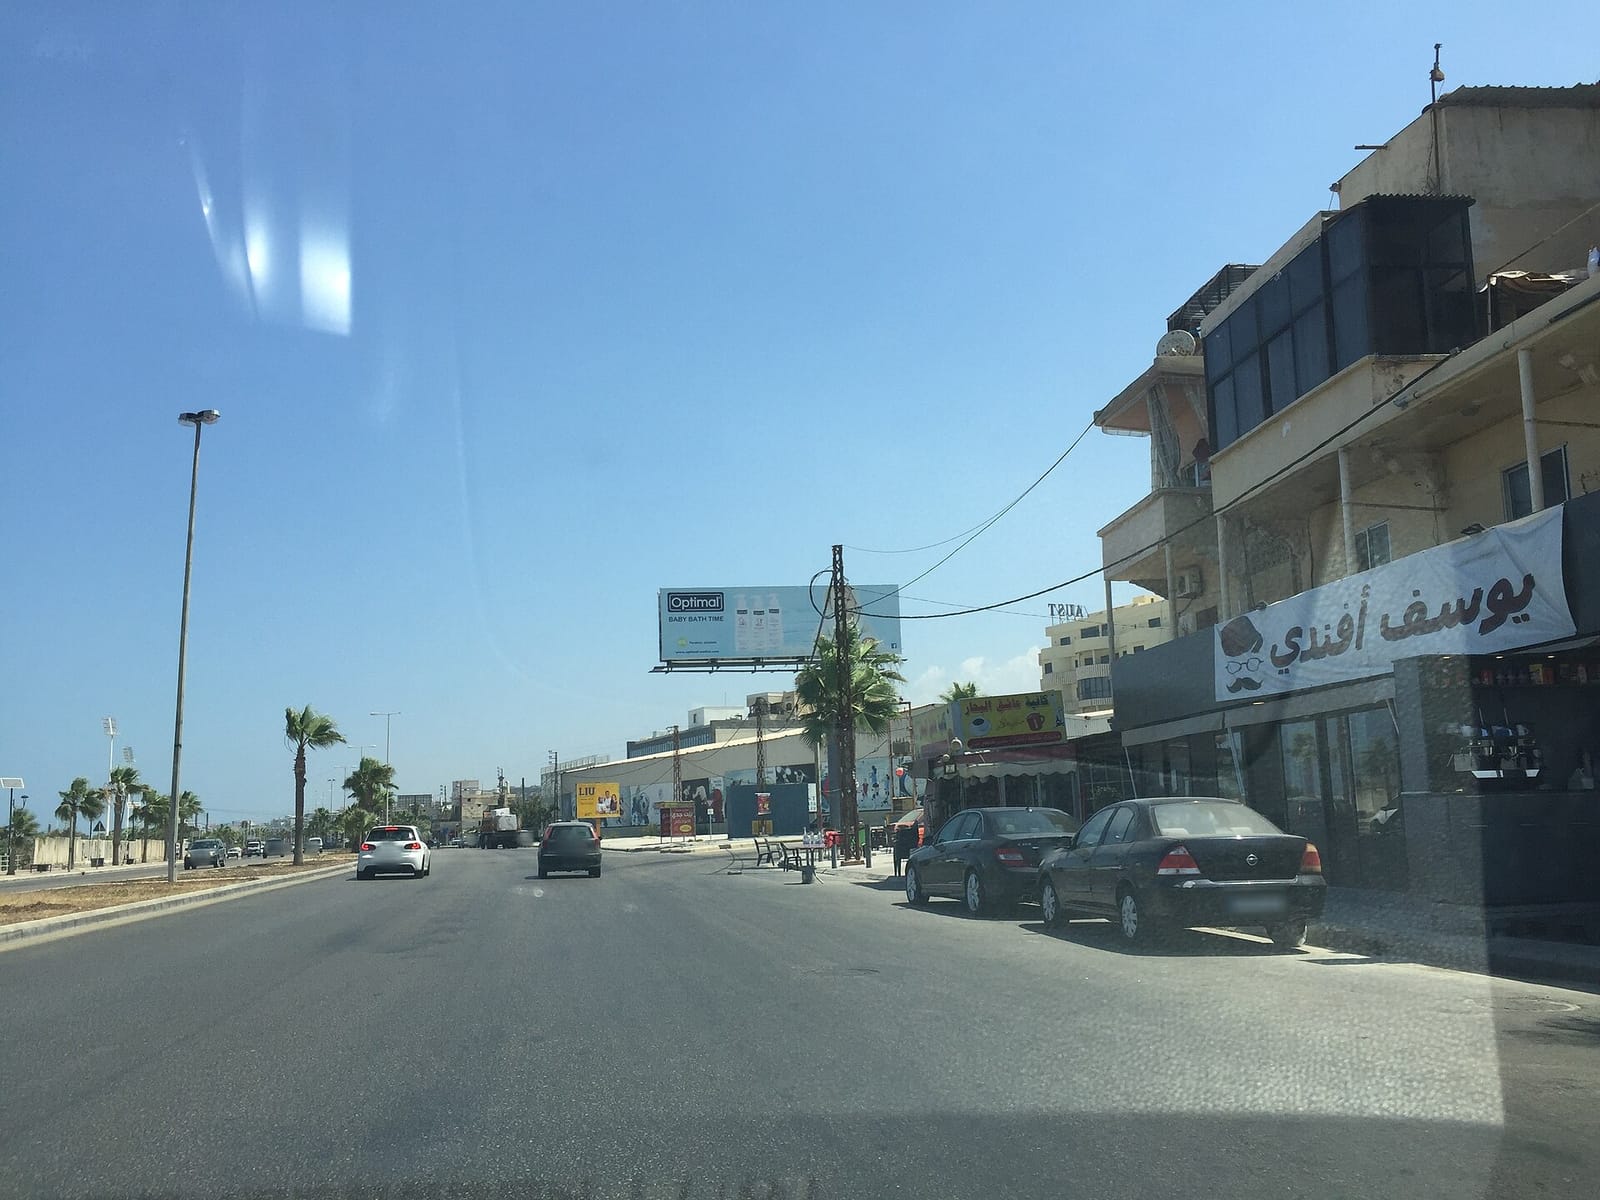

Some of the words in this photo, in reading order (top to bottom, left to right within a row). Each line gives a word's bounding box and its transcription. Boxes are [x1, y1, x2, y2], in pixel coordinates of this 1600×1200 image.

[671, 596, 720, 610] Optimal
[1380, 574, 1536, 641] يوسف
[1270, 584, 1371, 675] أفندي
[578, 787, 595, 796] LIU
